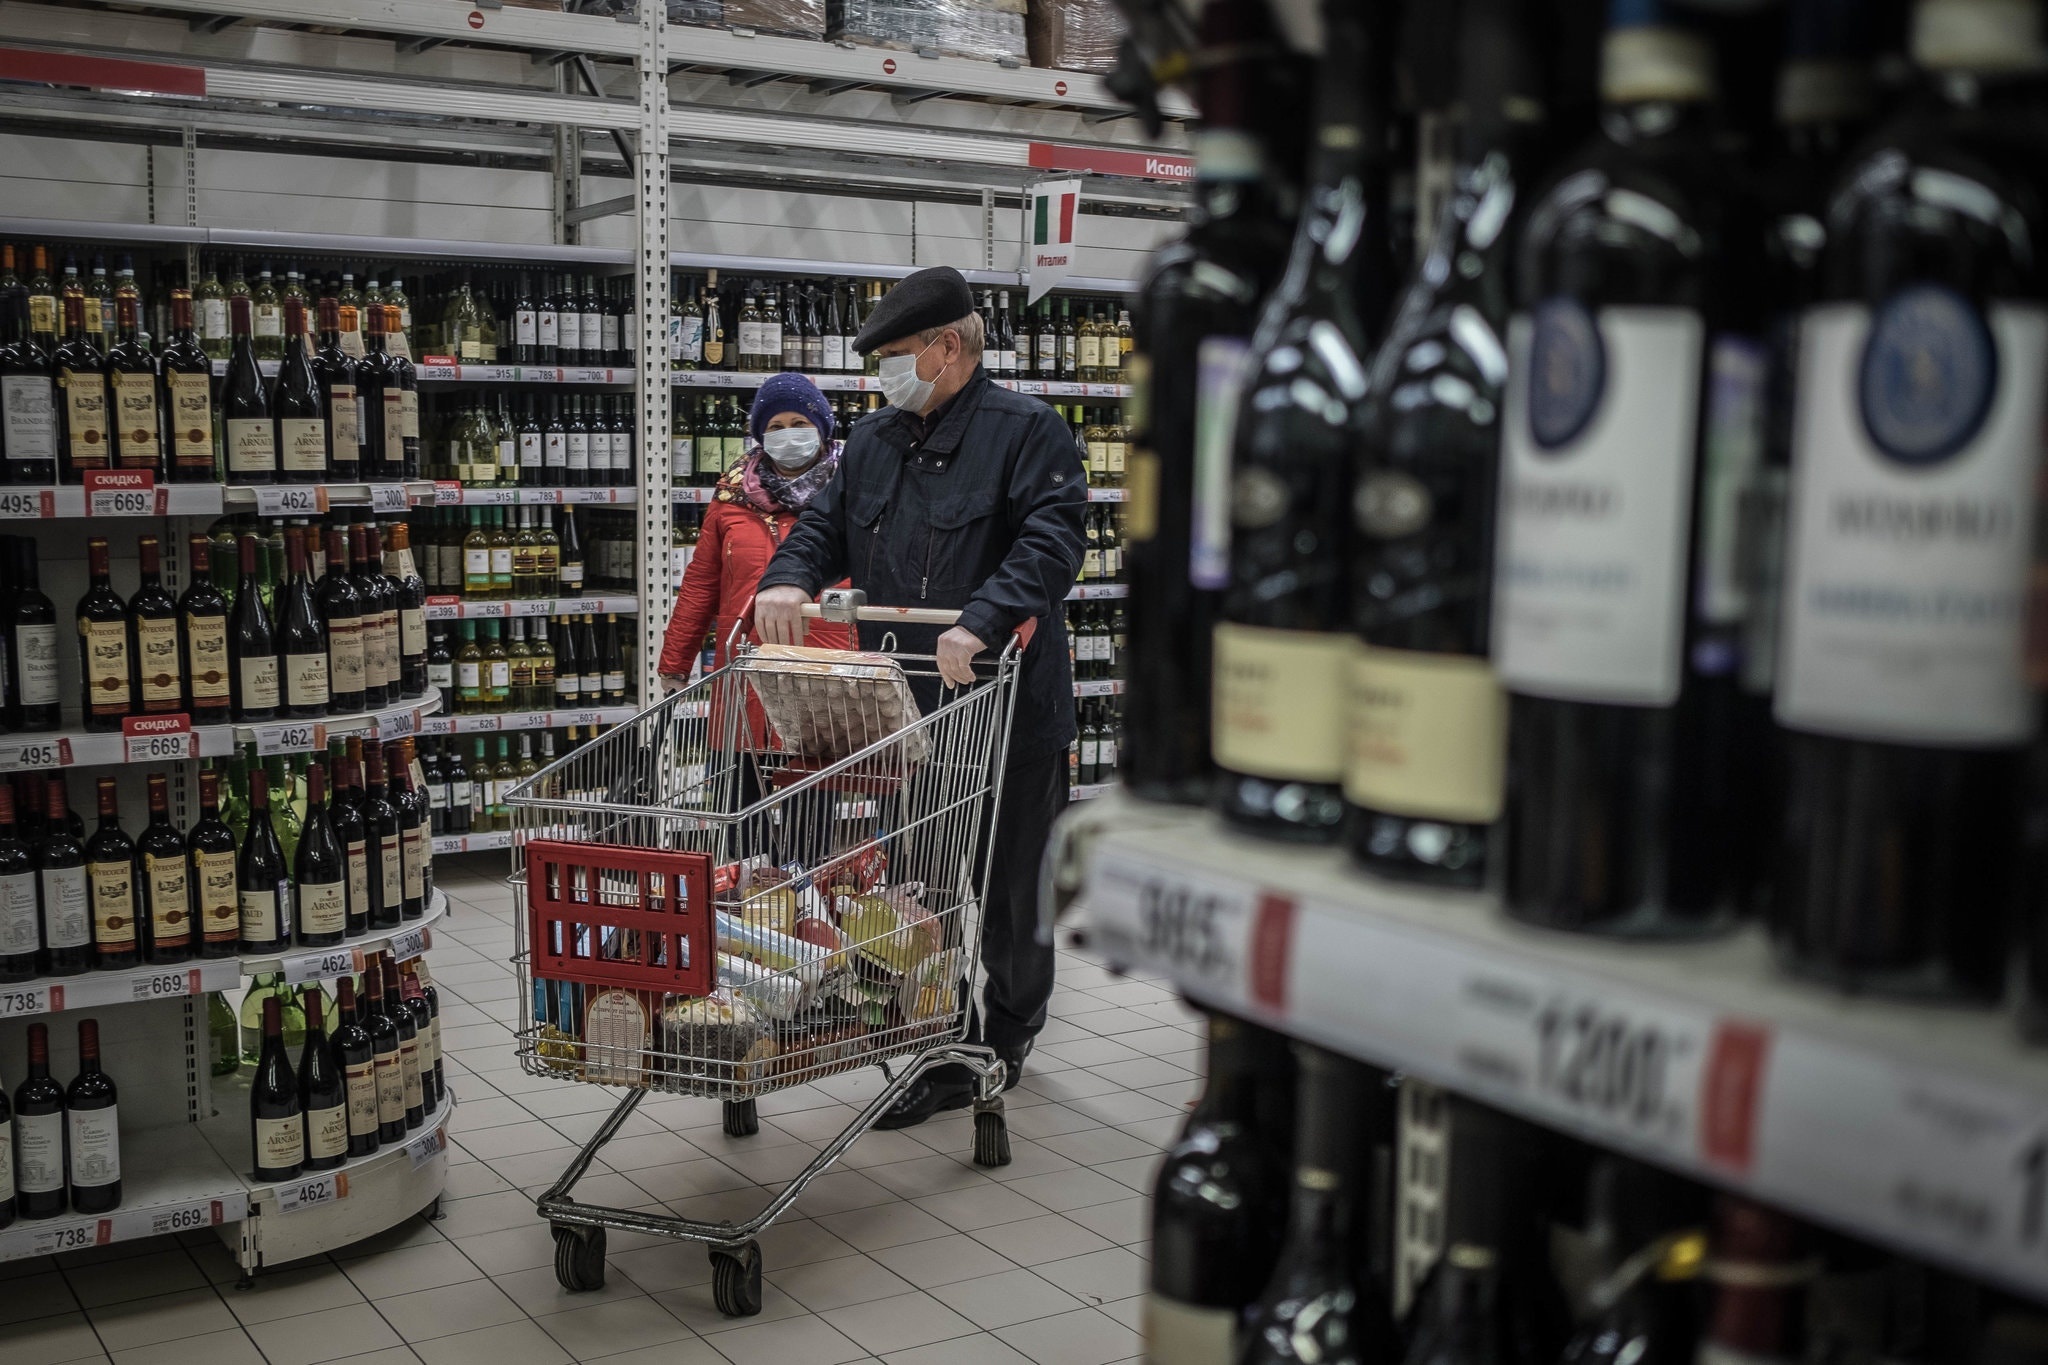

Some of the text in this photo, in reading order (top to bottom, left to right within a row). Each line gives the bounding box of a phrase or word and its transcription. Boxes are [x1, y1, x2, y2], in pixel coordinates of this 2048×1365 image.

[1037, 254, 1067, 267] Италия
[437, 369, 453, 377] 399
[495, 369, 511, 378] 915
[538, 370, 554, 379] 789
[586, 371, 601, 380] 700
[95, 475, 143, 487] СКИДКА
[281, 492, 308, 509] 462
[385, 490, 402, 506] 300
[440, 491, 456, 500] 399
[495, 493, 511, 501] 915
[538, 492, 554, 501] 789
[589, 491, 604, 500] 700
[679, 491, 692, 500] 634
[1, 495, 33, 514] 495
[114, 493, 145, 511] 669
[438, 607, 453, 616] 399
[486, 605, 501, 614] 626
[530, 604, 545, 613] 513
[580, 602, 595, 611] 603
[393, 715, 410, 734] 300
[479, 719, 494, 728] 626
[529, 716, 544, 725] 513
[579, 714, 594, 723] 603
[134, 719, 180, 732] СКИДКА
[432, 723, 448, 732] 593
[281, 729, 308, 746] 462
[151, 738, 180, 755] 669
[20, 747, 52, 764] 495
[443, 841, 459, 850] 593
[404, 934, 421, 953] 300
[321, 955, 346, 973] 462
[153, 975, 182, 994] 669
[5, 993, 36, 1013] 738
[422, 1136, 438, 1156] 300
[300, 1182, 326, 1203] 462
[172, 1209, 201, 1229] 669
[55, 1228, 86, 1248] 738
